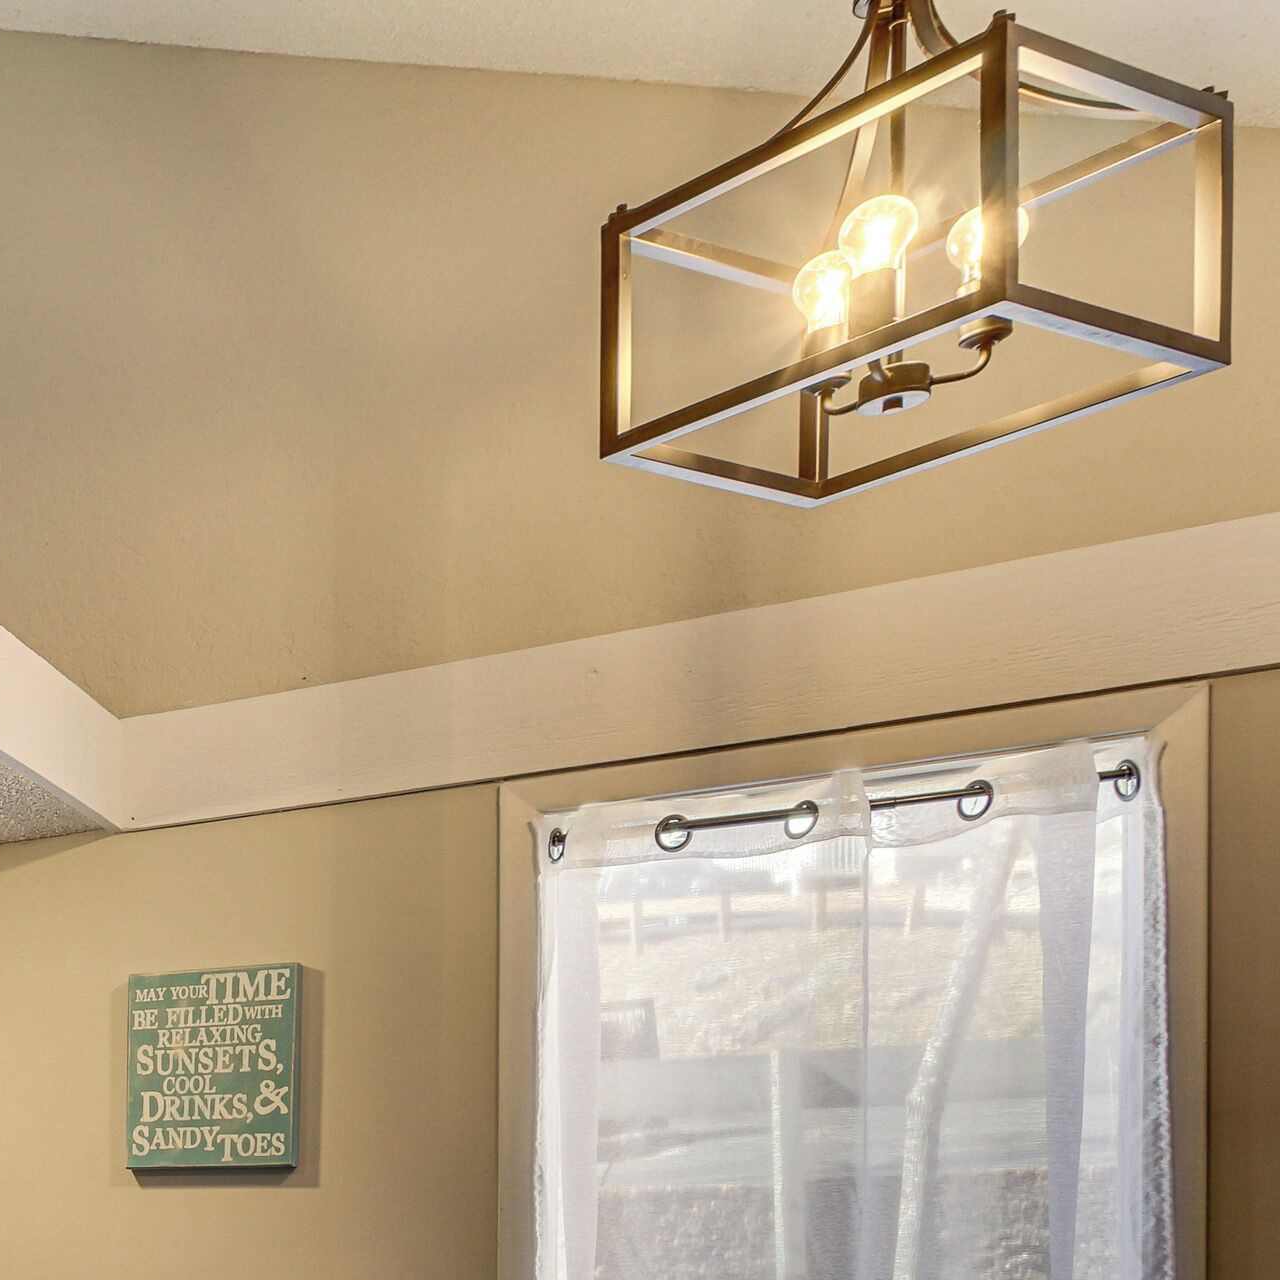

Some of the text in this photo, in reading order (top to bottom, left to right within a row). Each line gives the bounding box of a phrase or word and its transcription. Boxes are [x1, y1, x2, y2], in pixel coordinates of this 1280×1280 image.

[135, 968, 291, 1005] MAY YOUR TIME
[132, 1004, 283, 1030] BE FILLED WITH
[157, 1024, 263, 1049] RELAXING
[136, 1038, 284, 1075] SUNSETS,
[140, 1079, 289, 1124] DRINKS, &
[163, 1074, 216, 1095] COOL
[132, 1125, 285, 1162] SANDY TOES
